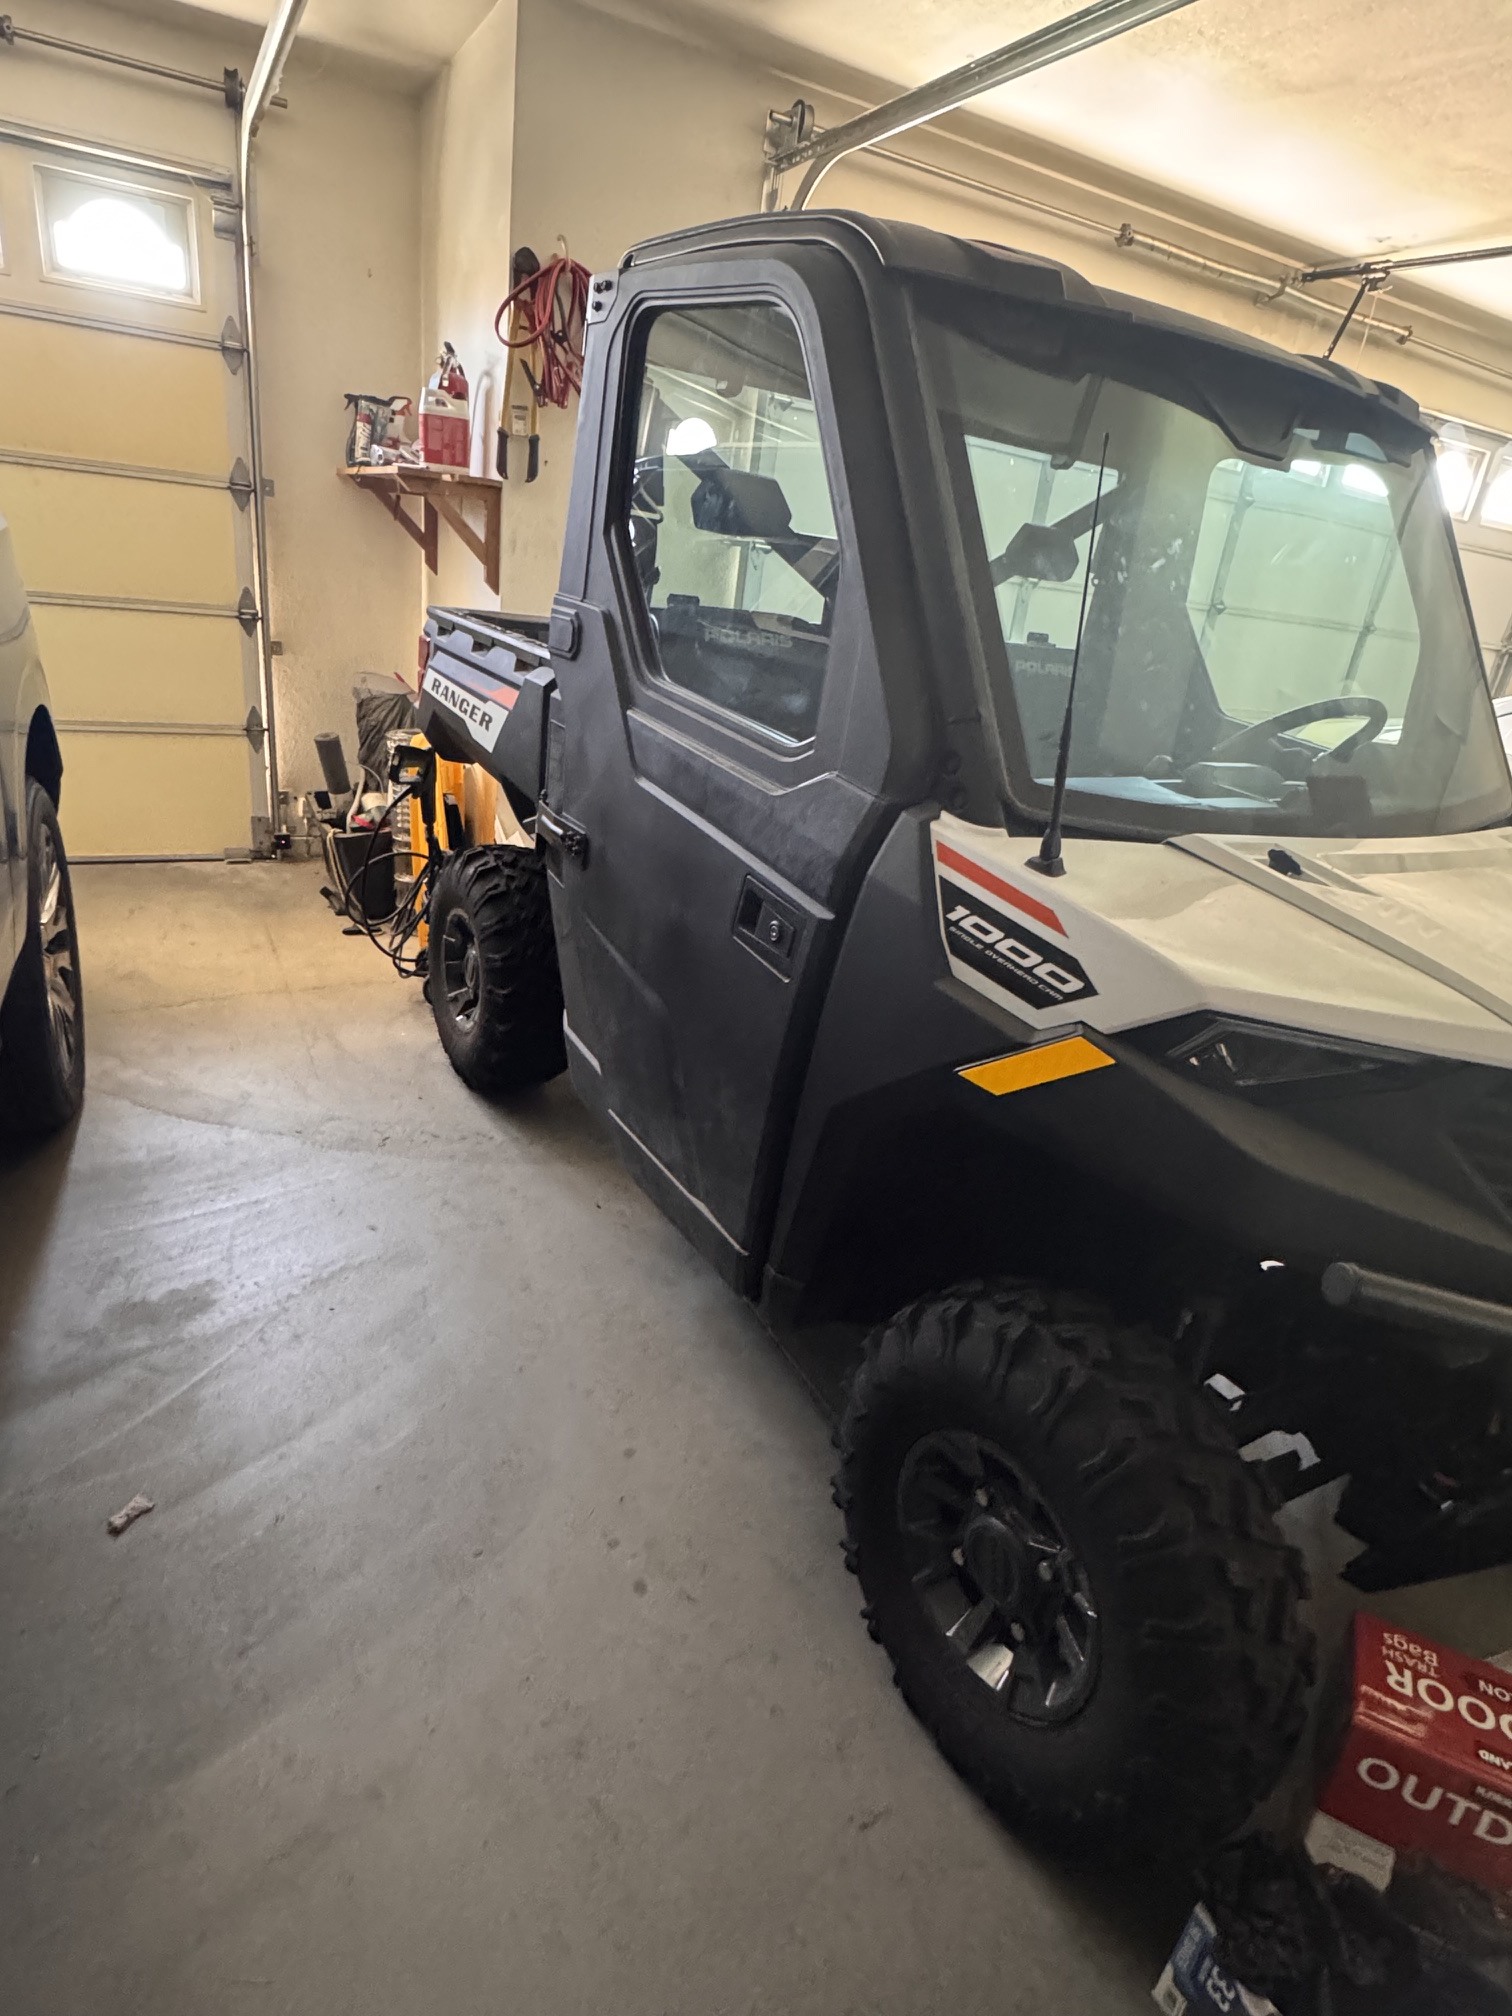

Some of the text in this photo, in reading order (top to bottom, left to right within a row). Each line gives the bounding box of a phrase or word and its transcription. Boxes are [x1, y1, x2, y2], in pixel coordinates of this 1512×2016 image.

[431, 678, 493, 732] RANGER
[945, 905, 1085, 994] 1000
[949, 926, 1063, 1000] SINGLE OVERHEAD CAM
[1382, 1632, 1439, 1667] Bags
[1382, 1645, 1441, 1679] TRASH
